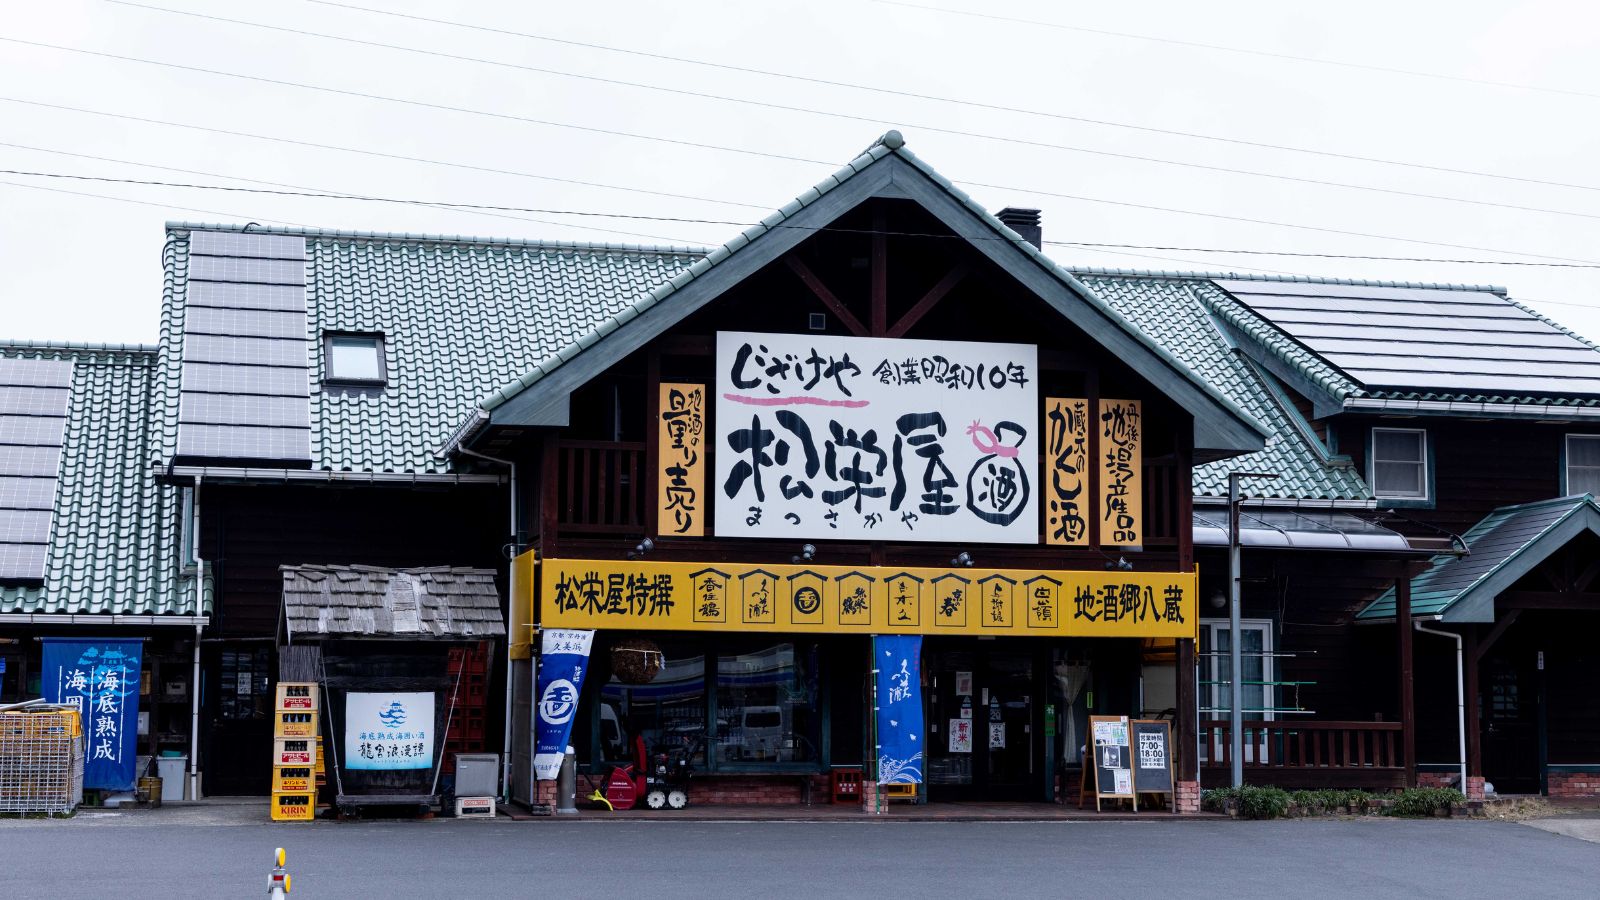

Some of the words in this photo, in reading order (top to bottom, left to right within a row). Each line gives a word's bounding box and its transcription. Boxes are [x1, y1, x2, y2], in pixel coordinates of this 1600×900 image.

[730, 342, 862, 397] じざけや
[872, 355, 1029, 390] 創業昭和10年
[687, 388, 703, 446] 地酒の
[1073, 401, 1087, 473] 蔵元の
[1126, 403, 1140, 451] 丹後の
[662, 388, 698, 533] 量り売り
[723, 409, 961, 515] 松栄屋
[1048, 401, 1086, 543] かくし酒
[1101, 403, 1137, 543] 地場産品
[978, 463, 1018, 512] 酒
[554, 571, 675, 617] 松栄屋特撰
[698, 577, 723, 618] 香住鶴
[1074, 584, 1185, 625] 地酒郷八蔵
[553, 641, 583, 652] 久美浜
[93, 669, 120, 761] 海底熟成
[1140, 750, 1163, 758] 18:00
[280, 806, 307, 815] KIRIN
